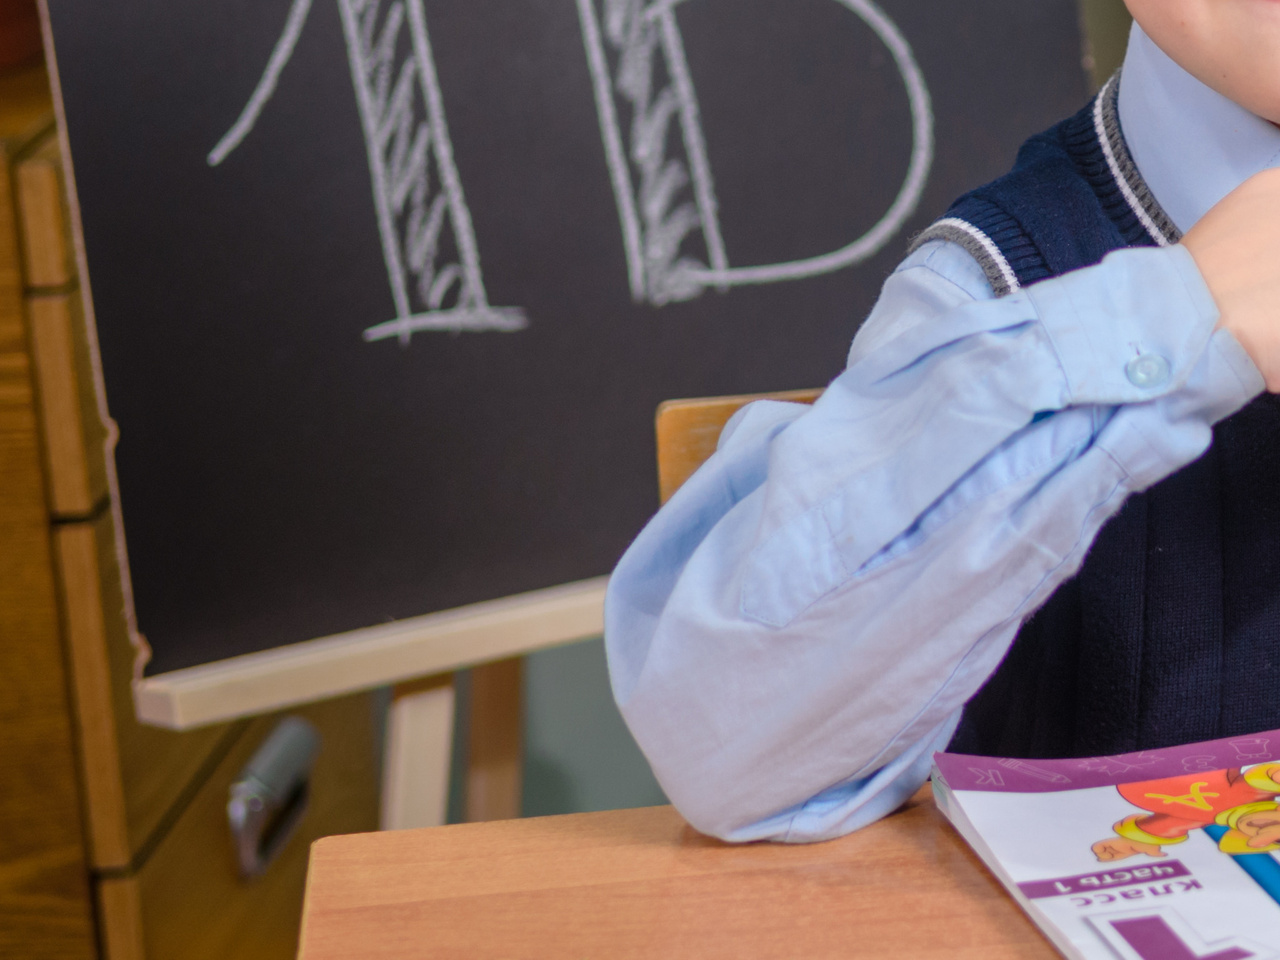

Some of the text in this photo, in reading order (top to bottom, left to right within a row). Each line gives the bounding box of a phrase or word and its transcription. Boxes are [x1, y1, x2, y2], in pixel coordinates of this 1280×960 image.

[1053, 865, 1176, 894] часть 1
[1069, 878, 1205, 908] класс
